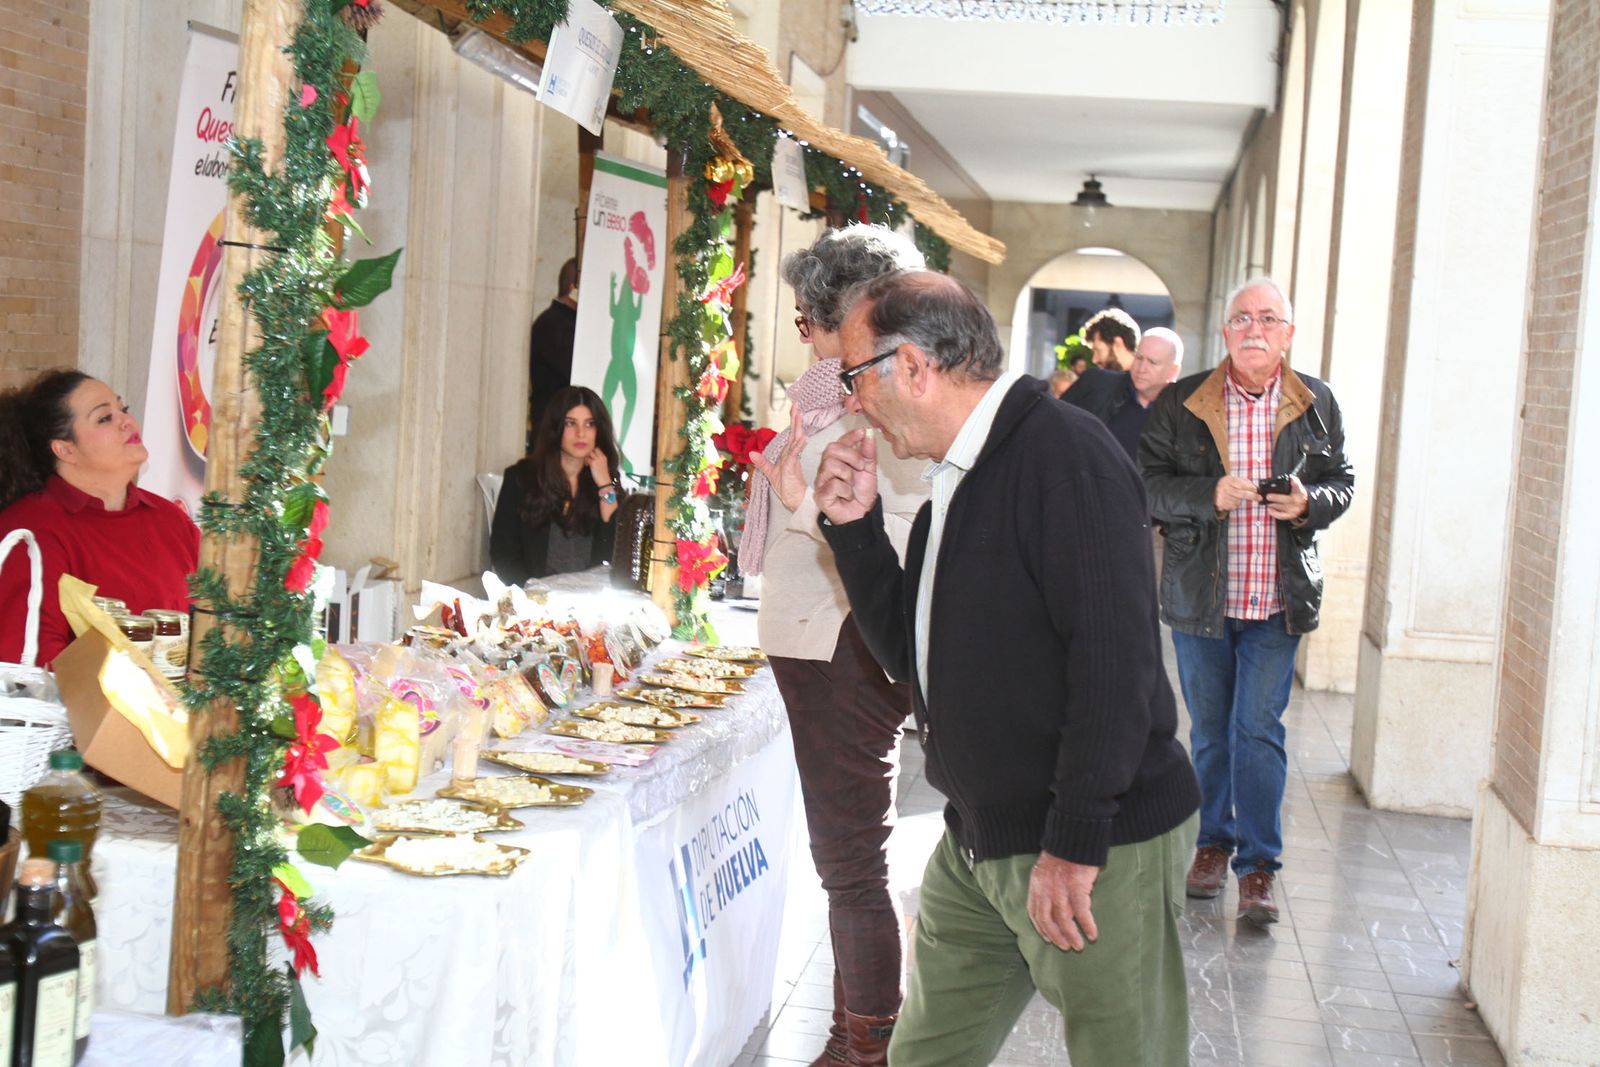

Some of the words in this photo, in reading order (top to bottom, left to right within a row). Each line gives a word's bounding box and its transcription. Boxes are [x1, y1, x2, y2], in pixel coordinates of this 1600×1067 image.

[692, 787, 761, 877] DIPUTACIÓN
[700, 883, 716, 930] DE
[713, 837, 769, 911] HUELVA
